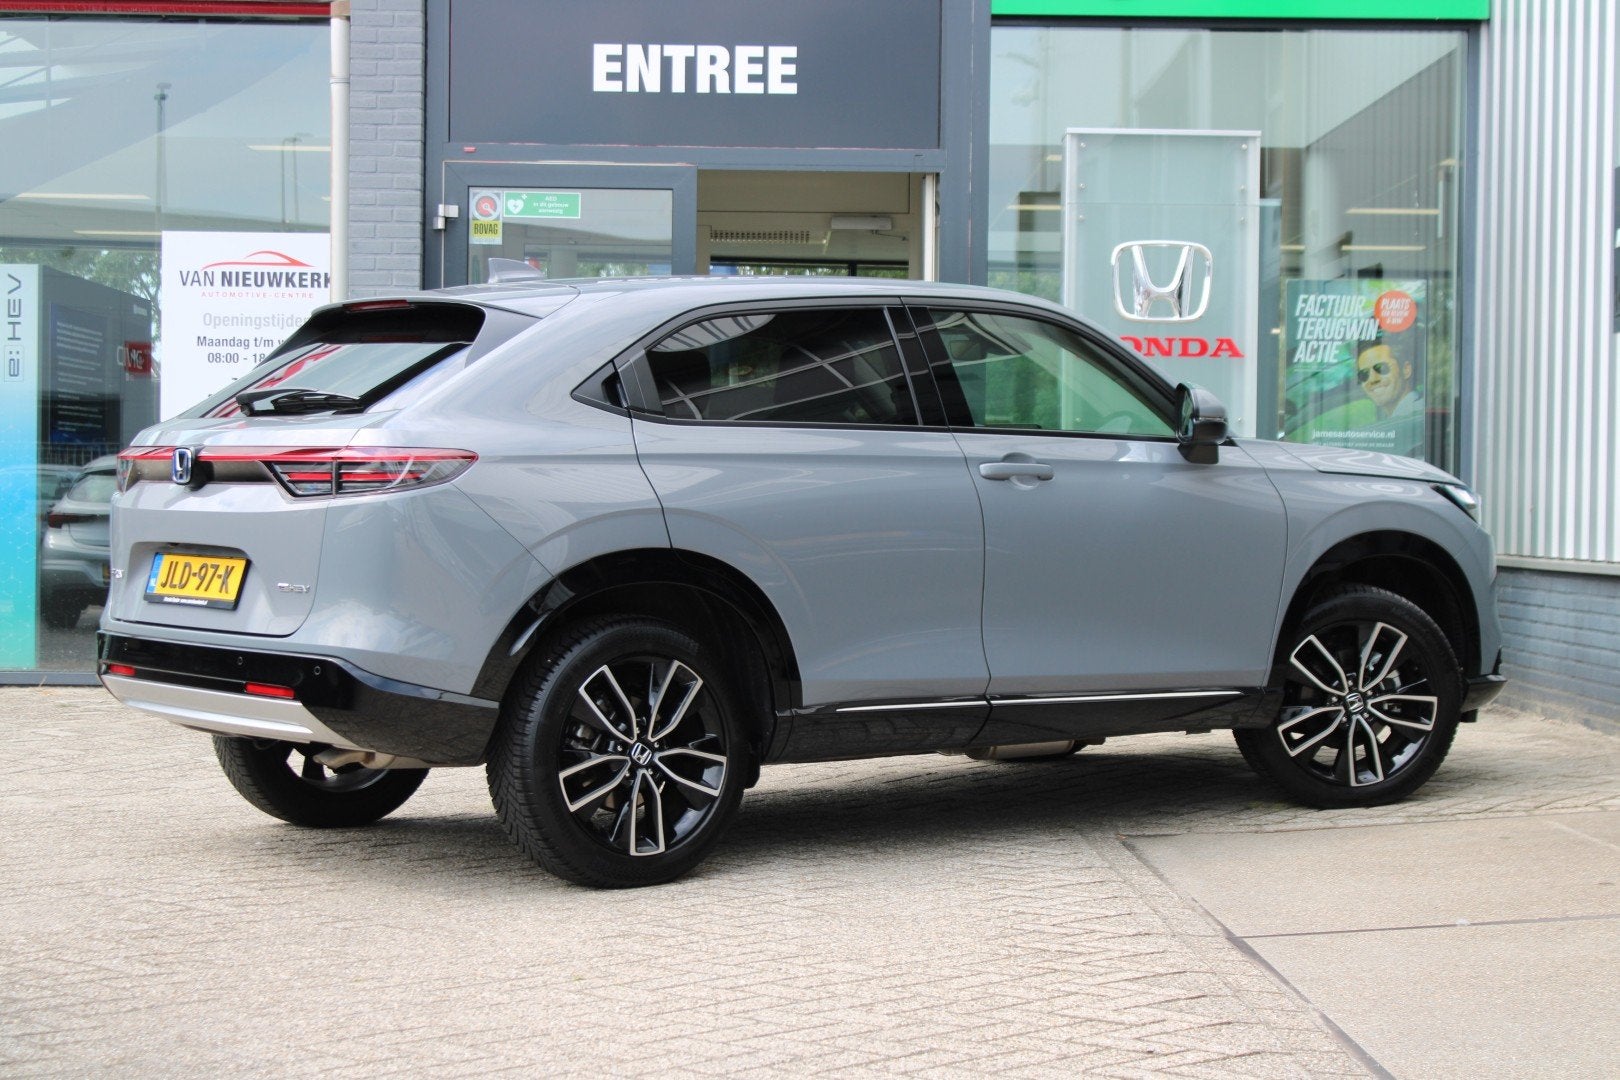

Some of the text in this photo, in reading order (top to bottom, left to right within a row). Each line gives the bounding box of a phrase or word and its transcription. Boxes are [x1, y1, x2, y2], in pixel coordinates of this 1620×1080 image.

[593, 43, 798, 95] ENTREE
[474, 223, 498, 235] BOVAG
[179, 270, 215, 286] VAN
[1295, 294, 1367, 317] FACTUUR
[1296, 317, 1380, 341] TERUGWIN
[197, 336, 250, 350] Maandag
[254, 337, 274, 348] t/m
[1119, 335, 1245, 358] NDA
[1293, 341, 1342, 363] ACTIE
[207, 352, 239, 363] 08:00
[160, 560, 236, 594] JLD-97-K
